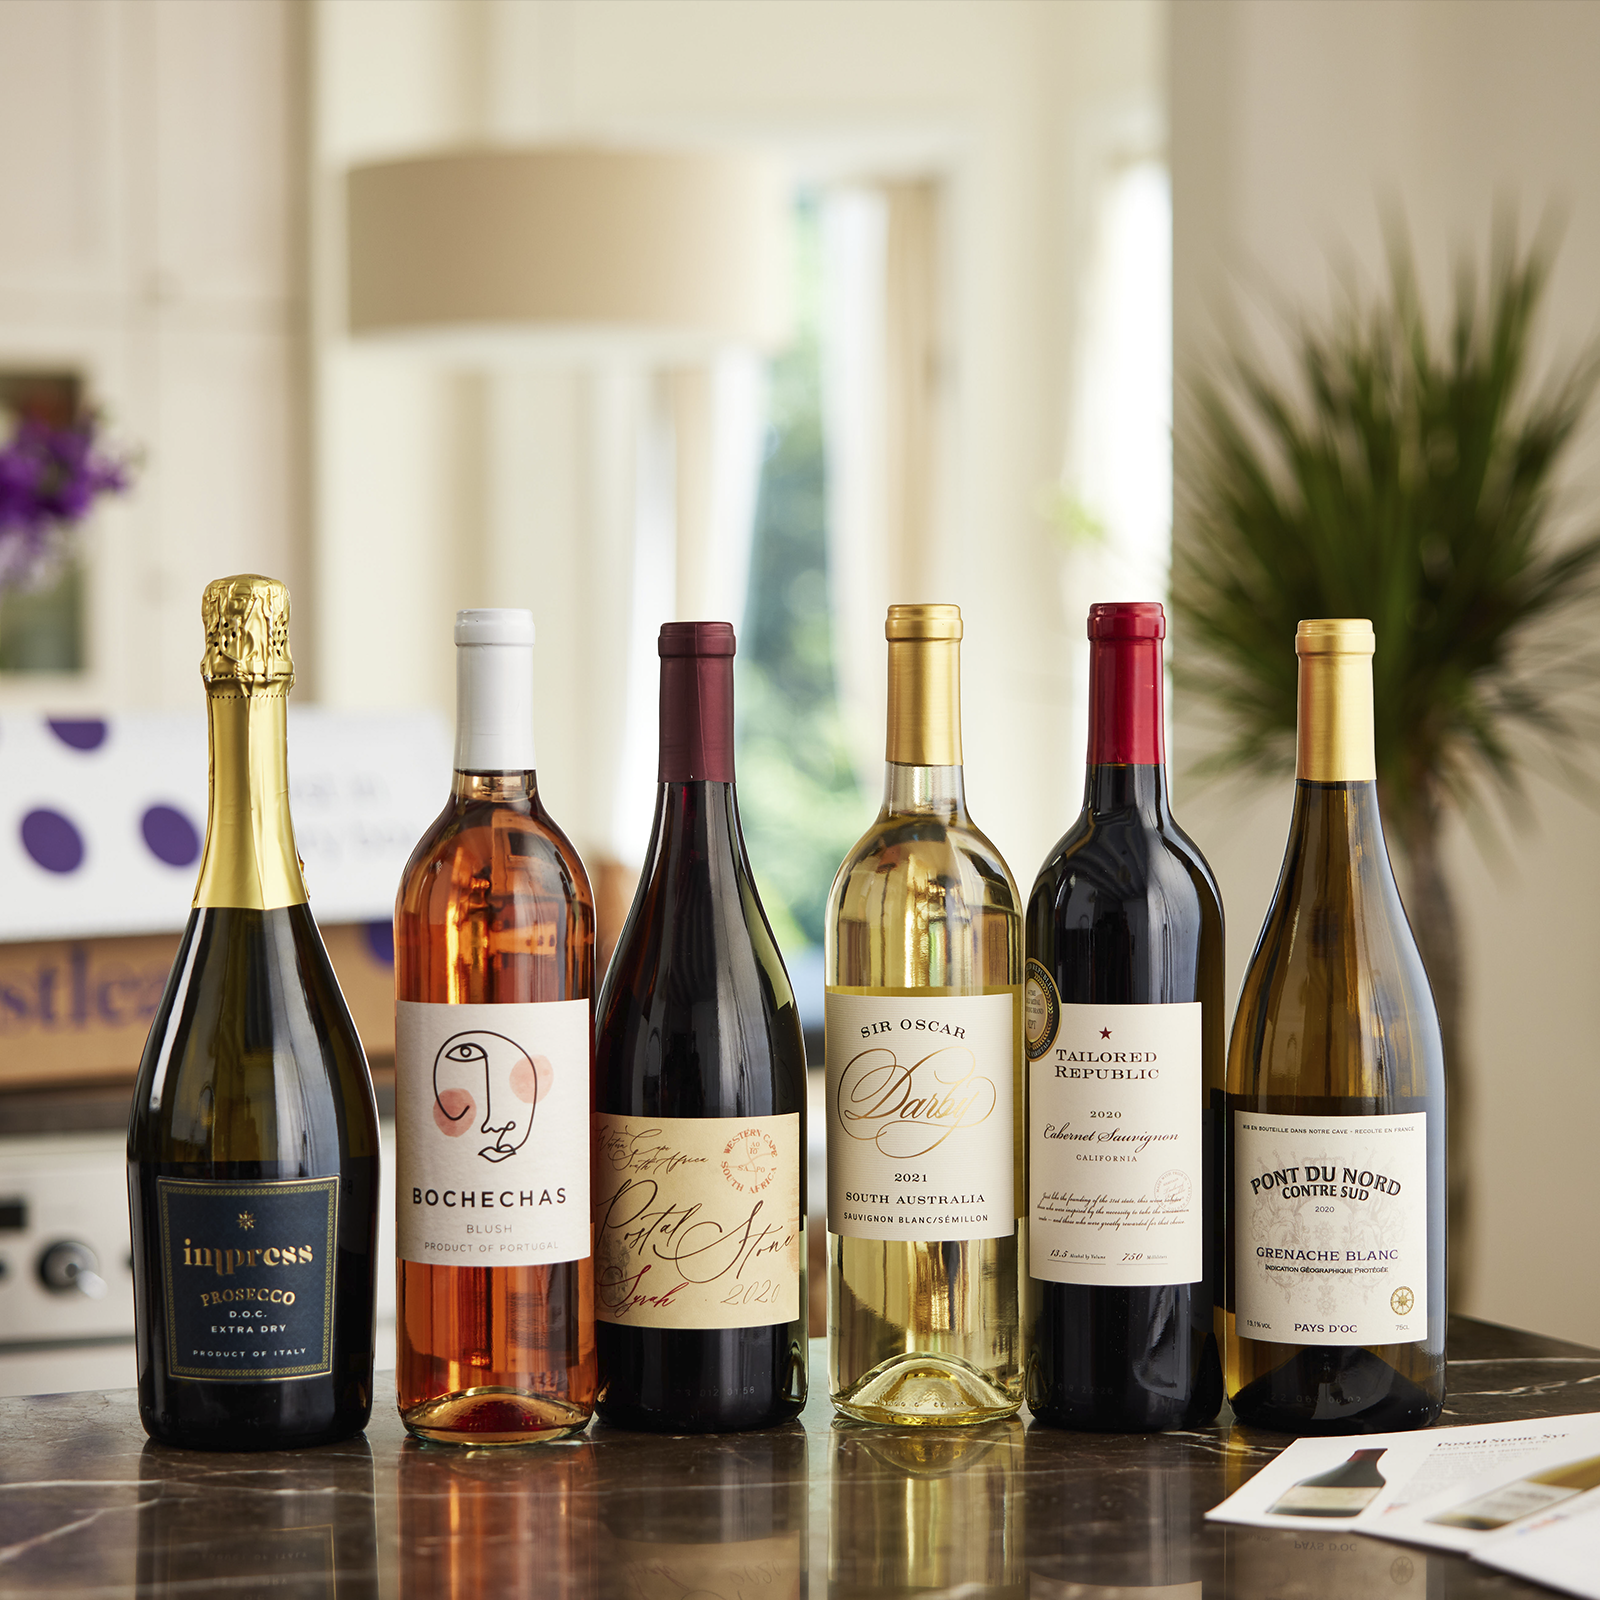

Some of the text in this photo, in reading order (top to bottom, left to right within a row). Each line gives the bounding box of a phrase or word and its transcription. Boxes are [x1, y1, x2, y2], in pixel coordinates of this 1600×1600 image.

[860, 1018, 967, 1039] SIR OSCAR
[1055, 1049, 1157, 1062] TAILORED
[1055, 1065, 1159, 1080] REPUBLIC
[837, 1046, 997, 1159] Darby
[1090, 1110, 1122, 1119] 2020
[723, 1128, 778, 1157] WESTERN CAPE
[1043, 1122, 1179, 1153] Cabernet Sauvignon
[608, 1149, 709, 1174] South Africa
[1076, 1154, 1138, 1162] CALIFORNIA
[721, 1161, 777, 1194] SOUTH AFRICA
[894, 1173, 928, 1183] 2021
[1250, 1166, 1401, 1196] PONT DU NORD
[412, 1187, 567, 1208] BOCHECHAS
[845, 1191, 986, 1205] SOUTH AUSTRALIA
[1282, 1184, 1369, 1201] CONTRE SUD
[1066, 1193, 1091, 1207] founding
[1092, 1194, 1101, 1207] of
[1099, 1194, 1107, 1203] the
[1137, 1194, 1148, 1203] this
[1066, 1206, 1088, 1218] inspired
[1087, 1205, 1094, 1219] by
[1095, 1205, 1104, 1214] the
[1106, 1209, 1130, 1219] necessity
[1139, 1205, 1151, 1214] take
[1152, 1205, 1161, 1214] the
[1315, 1205, 1335, 1213] 2020
[843, 1212, 989, 1224] SAUVIGNON BLANC/SÉMILLON
[1075, 1216, 1086, 1225] who
[1098, 1217, 1121, 1231] greatly
[1122, 1218, 1149, 1226] rewarded
[1146, 1217, 1156, 1231] for
[1158, 1217, 1169, 1225] that
[466, 1224, 513, 1234] BLUSH
[596, 1179, 794, 1284] Postal Stone
[424, 1242, 559, 1252] PRODUCT OF PORTUGAL
[1050, 1249, 1069, 1258] 13.5
[1256, 1247, 1399, 1261] GRENACHE BLANC
[183, 1238, 314, 1276] impress
[1122, 1252, 1143, 1261] 750
[200, 1288, 296, 1306] PROSECCO
[597, 1264, 689, 1318] Syrah
[720, 1279, 781, 1306] 2020
[229, 1310, 268, 1318] D.O.C.
[261, 1324, 287, 1333] DRY
[1294, 1323, 1357, 1333] PAYS D'OC
[193, 1349, 245, 1358] PRODUCT
[274, 1348, 307, 1356] ITALY
[1437, 1438, 1488, 1448] Postal
[1490, 1435, 1537, 1443] Stone
